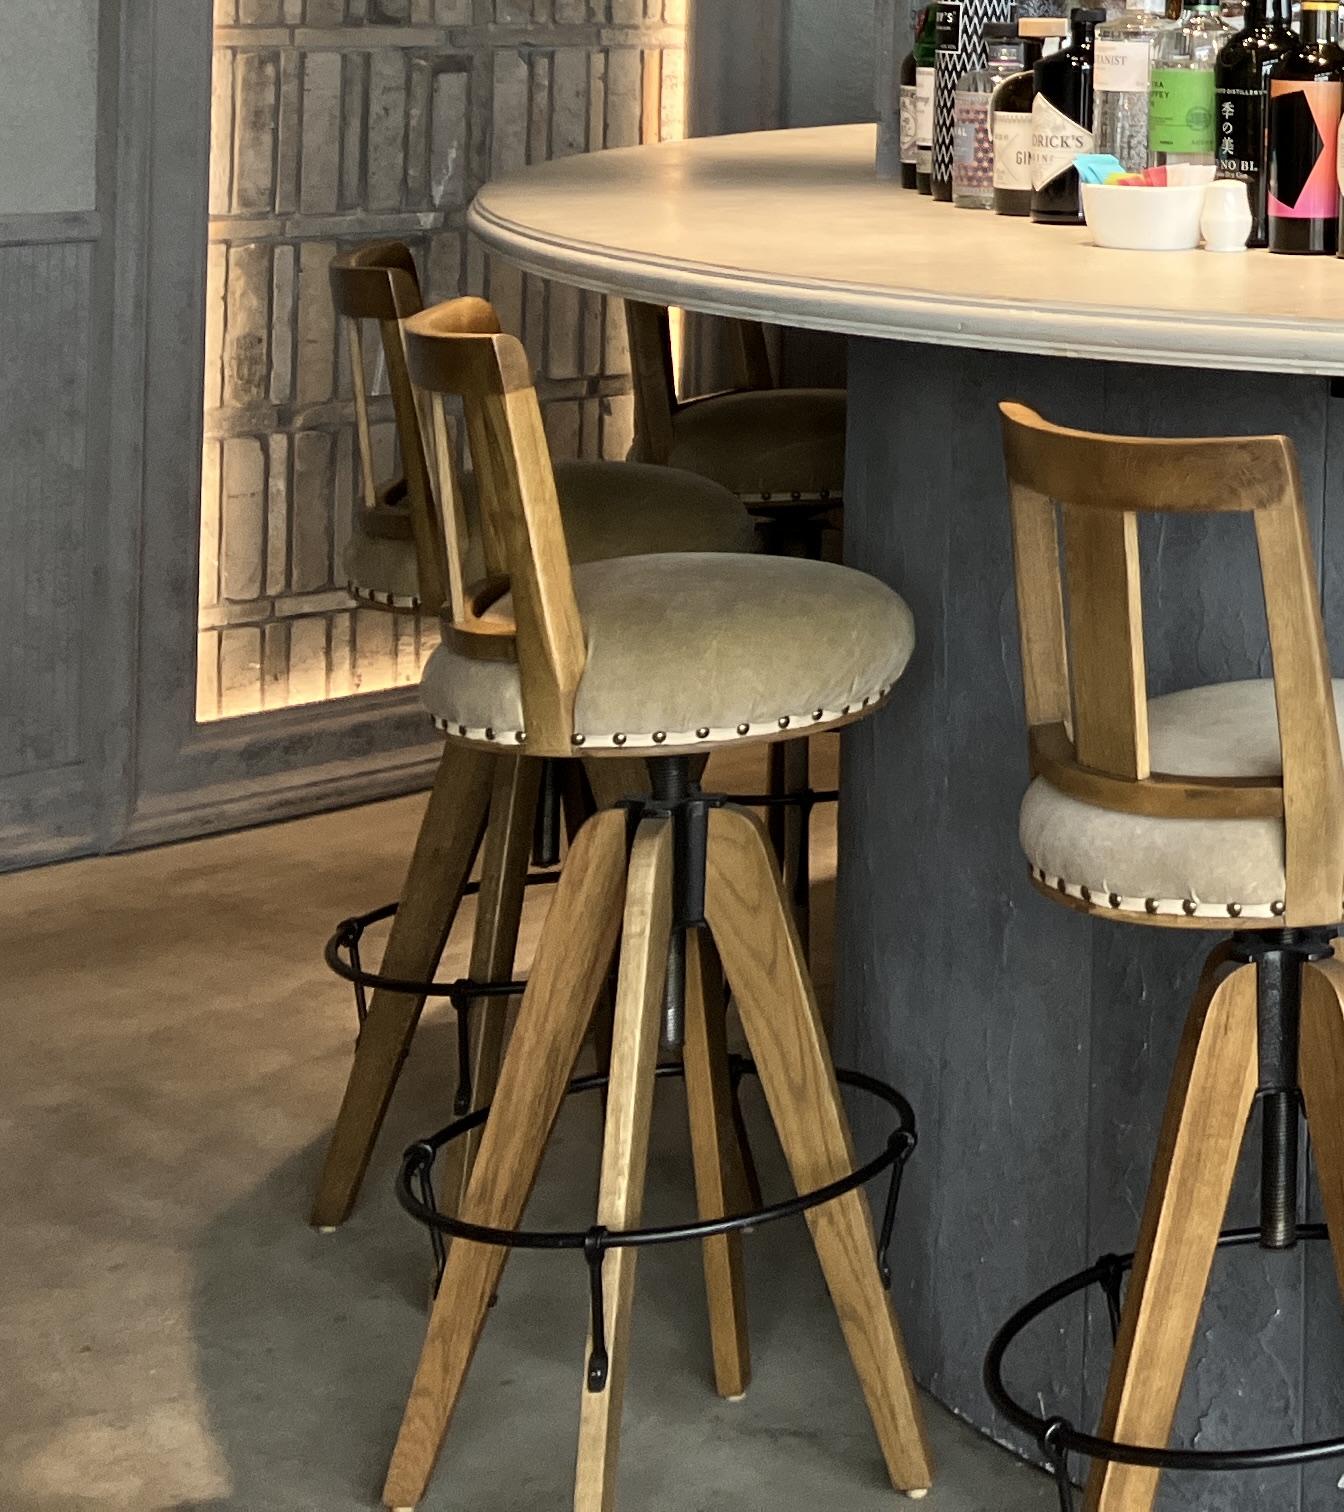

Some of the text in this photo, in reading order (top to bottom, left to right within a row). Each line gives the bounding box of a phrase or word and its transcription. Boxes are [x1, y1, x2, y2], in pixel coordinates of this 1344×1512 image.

[1221, 101, 1235, 155] 季の美
[1032, 135, 1084, 149] DRICK'S
[1221, 159, 1237, 170] NO
